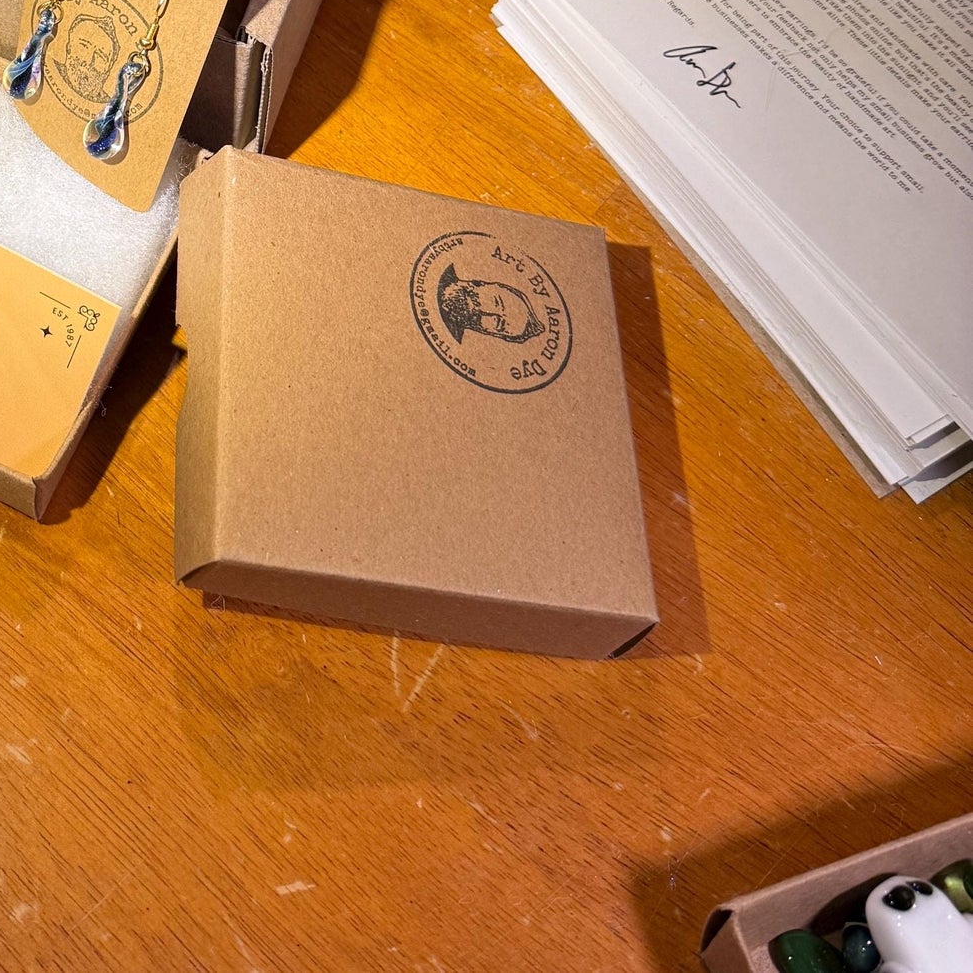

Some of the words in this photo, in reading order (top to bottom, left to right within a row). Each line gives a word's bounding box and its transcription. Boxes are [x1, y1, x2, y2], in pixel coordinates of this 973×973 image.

[491, 245, 526, 273] Art
[528, 273, 550, 298] By
[413, 237, 477, 377] artbyaarondye@gmail.com
[52, 307, 70, 321] EST
[65, 323, 75, 348] 1987
[540, 304, 561, 360] Aaron
[509, 358, 547, 381] Dye
